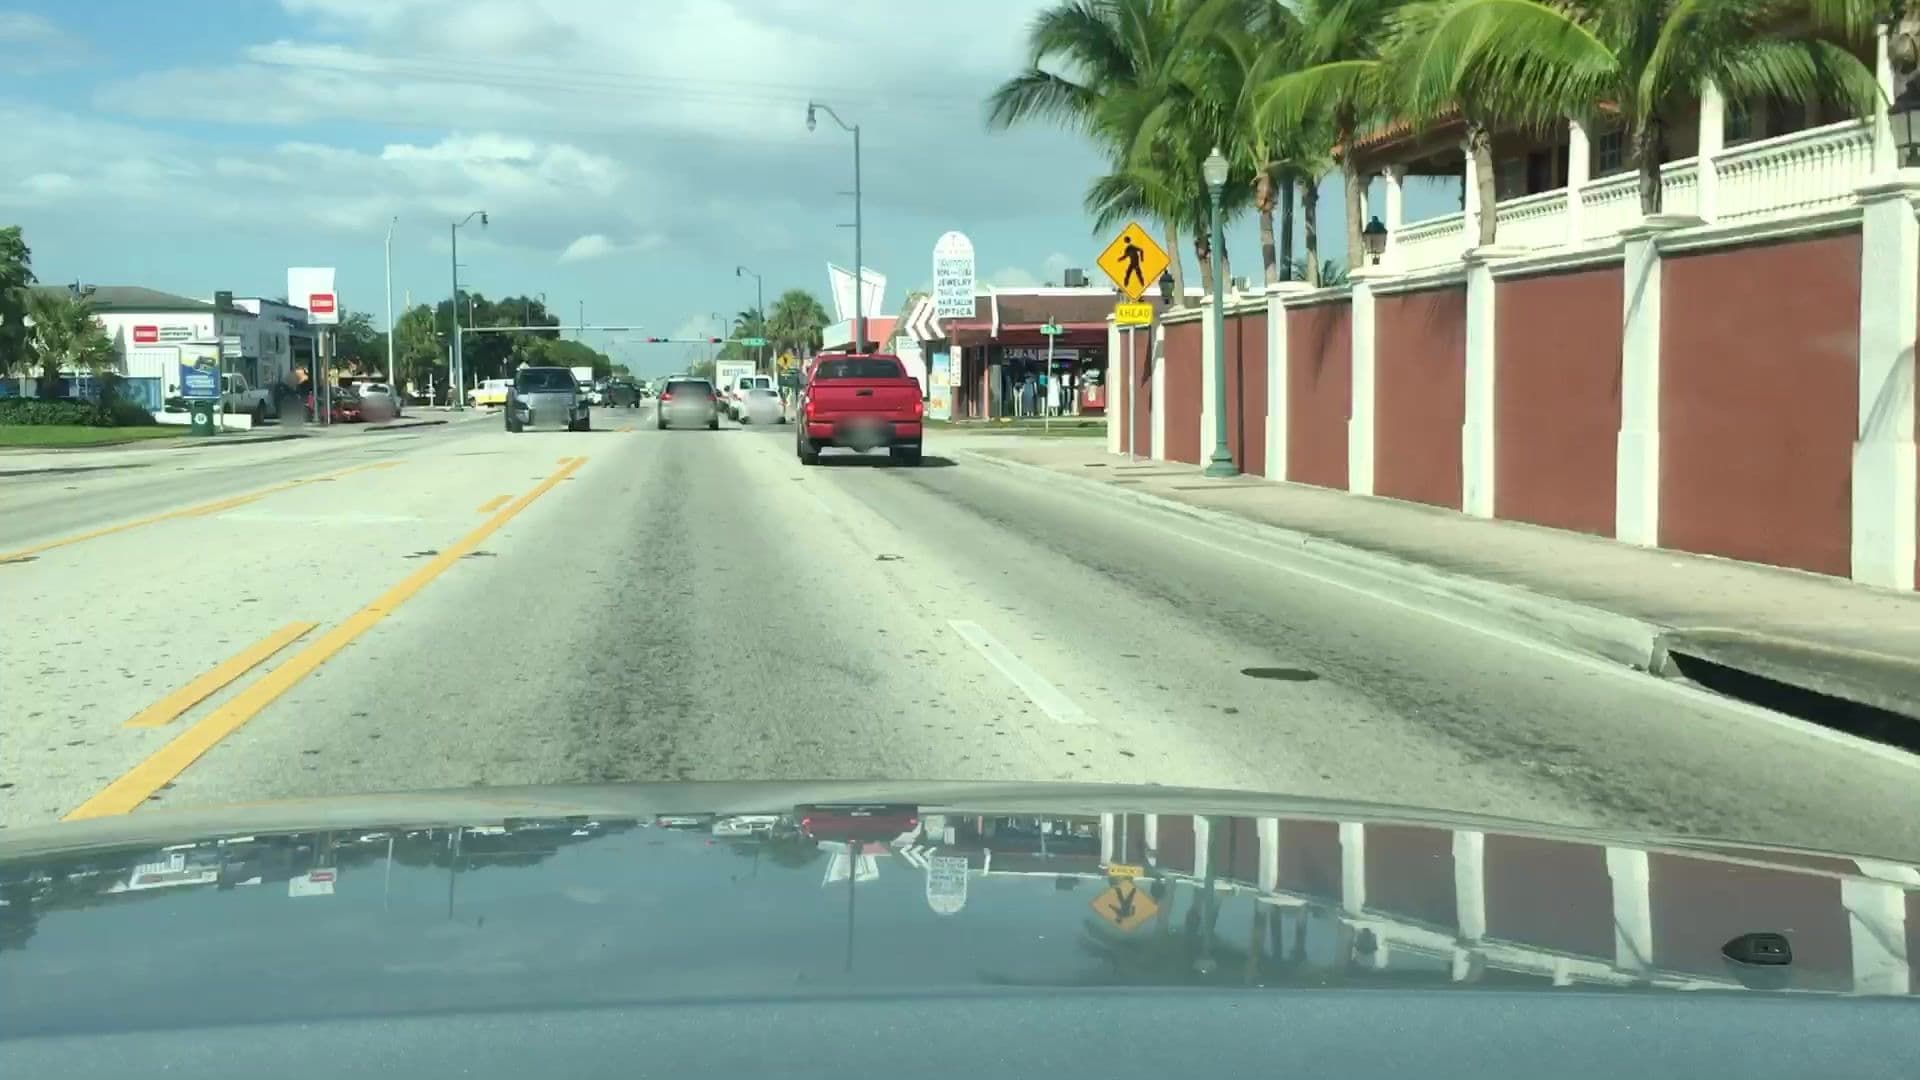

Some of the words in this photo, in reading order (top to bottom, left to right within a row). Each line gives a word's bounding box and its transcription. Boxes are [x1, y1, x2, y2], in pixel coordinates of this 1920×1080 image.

[938, 278, 972, 287] JEWELRY
[938, 307, 972, 316] OPTICA
[1119, 309, 1149, 318] AHEAD
